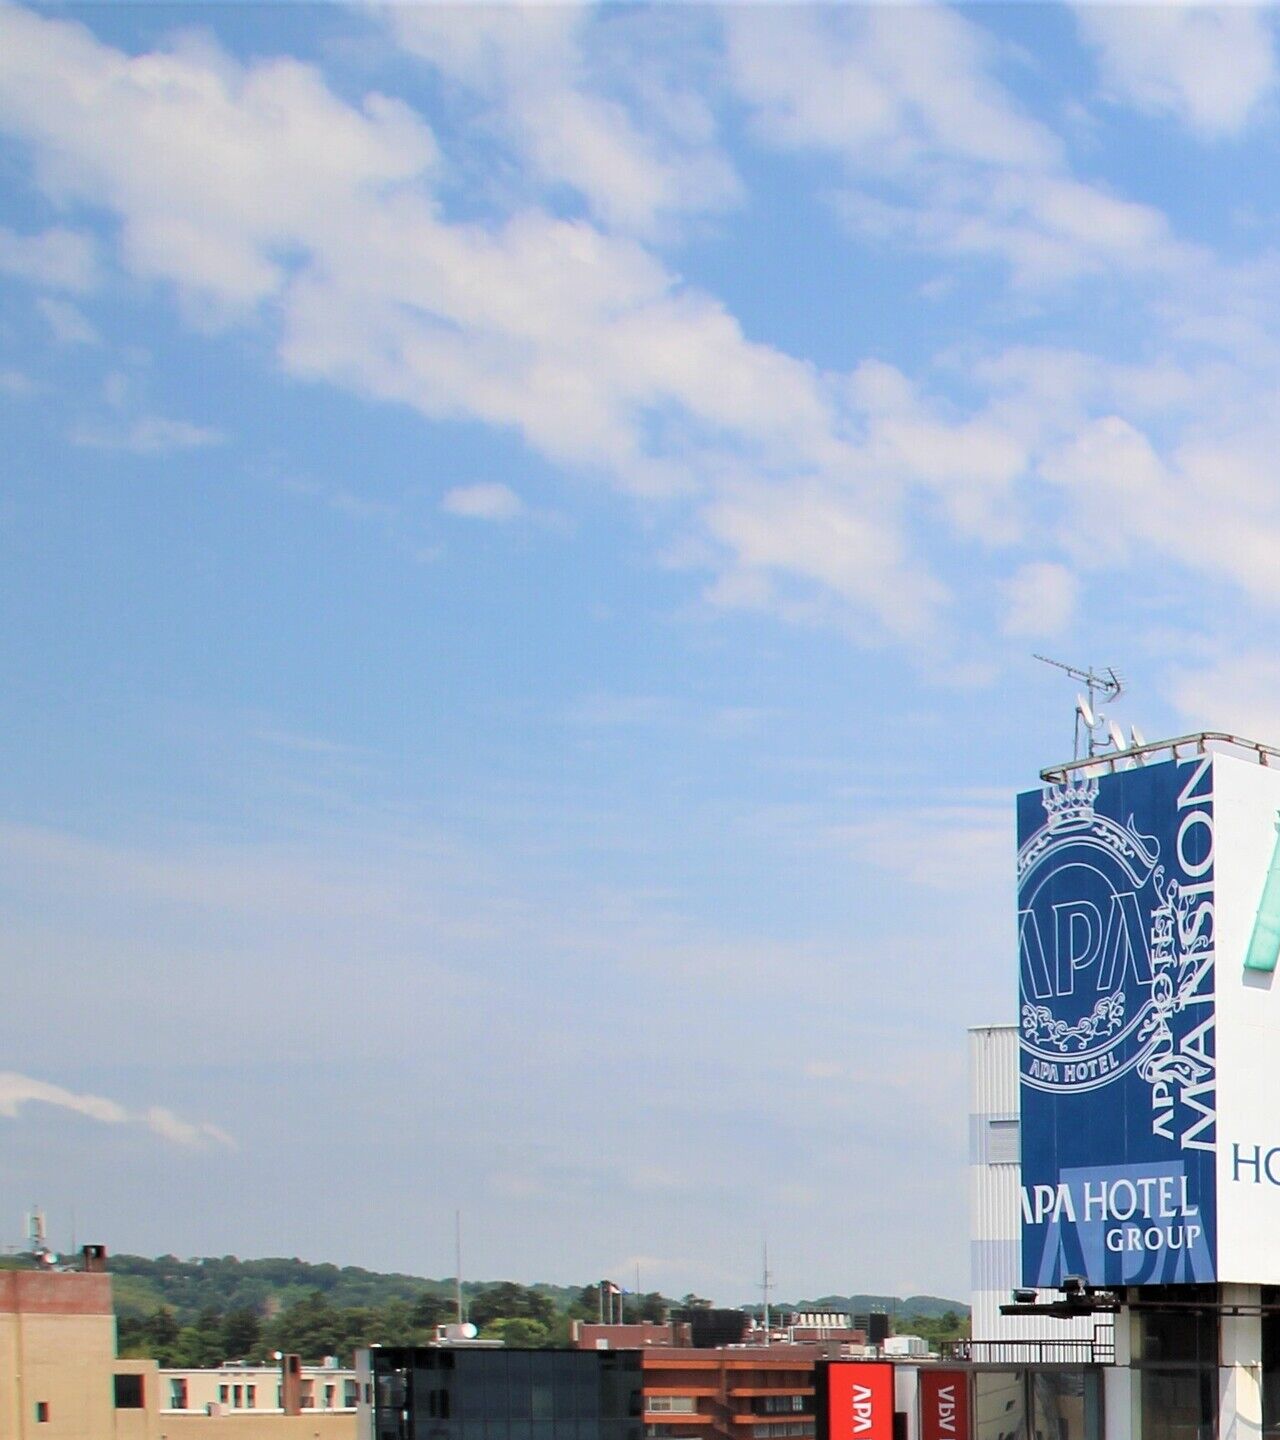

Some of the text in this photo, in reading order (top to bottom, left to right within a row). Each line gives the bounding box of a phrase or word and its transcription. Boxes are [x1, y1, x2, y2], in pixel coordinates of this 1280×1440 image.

[1176, 752, 1217, 1152] MANSION
[1029, 1051, 1119, 1083] APA HOTEL
[1084, 1176, 1199, 1222] HOTEL
[1106, 1225, 1201, 1252] GROUP
[852, 1384, 872, 1434] APA
